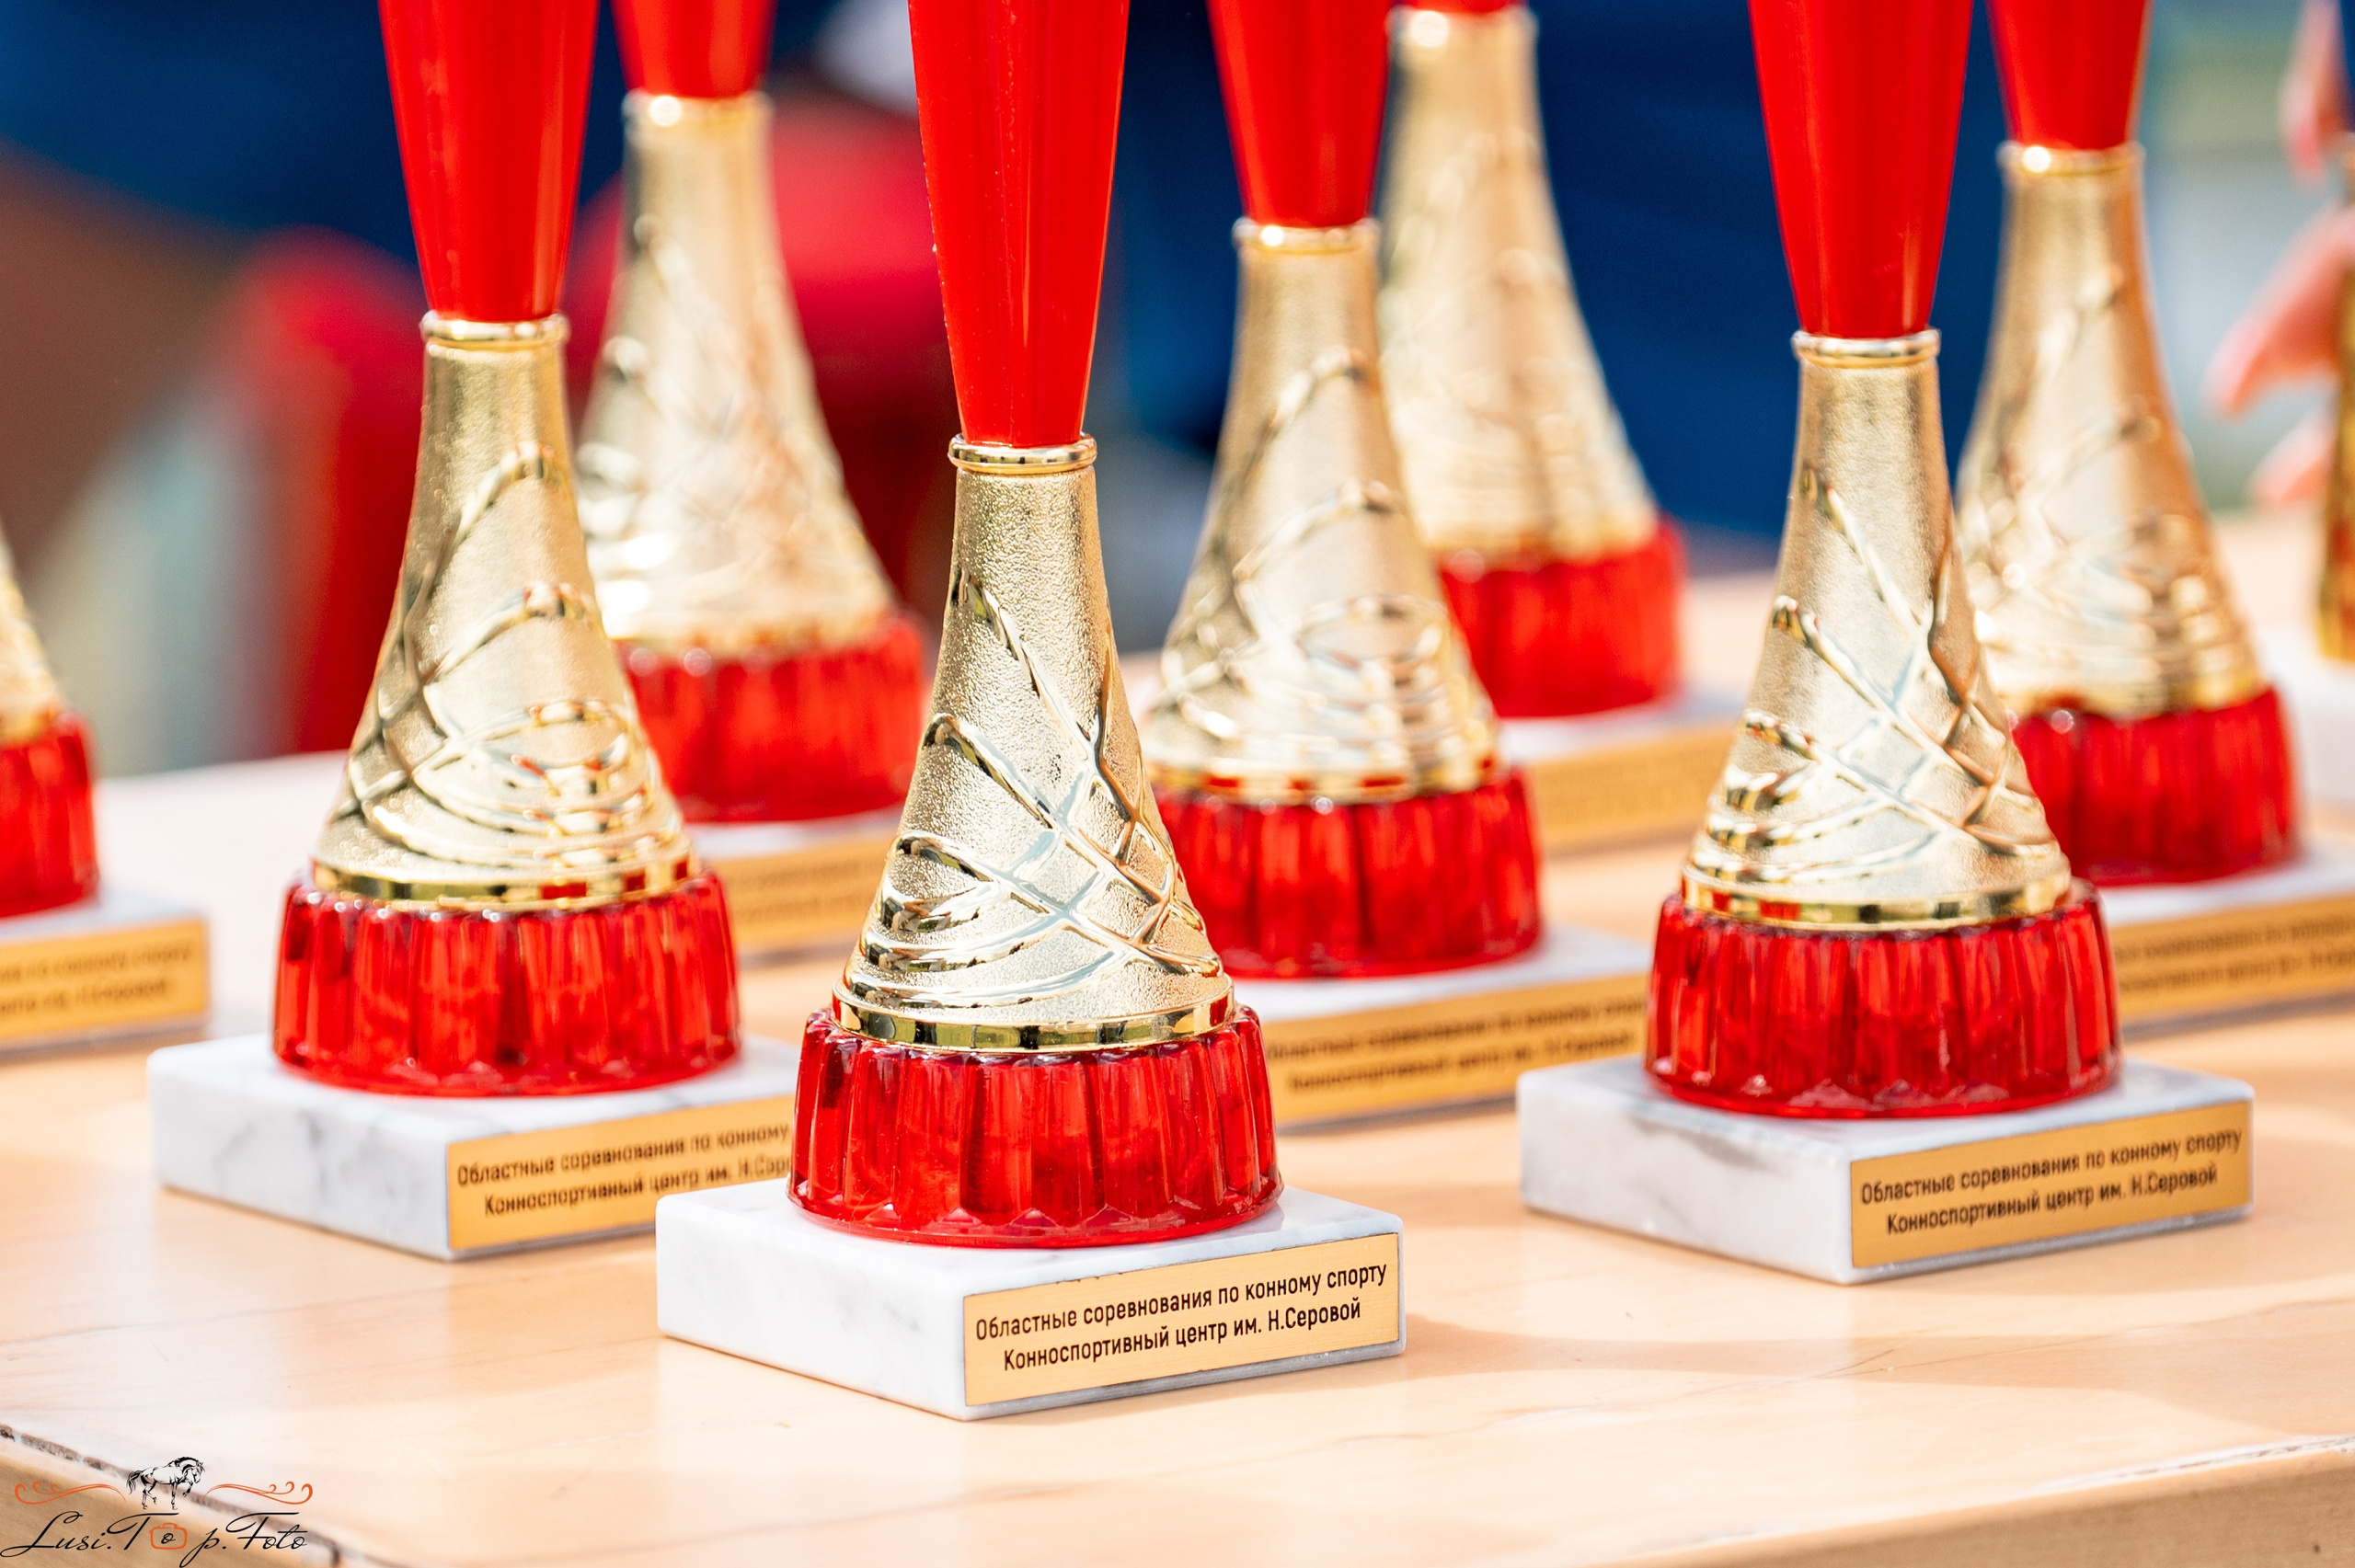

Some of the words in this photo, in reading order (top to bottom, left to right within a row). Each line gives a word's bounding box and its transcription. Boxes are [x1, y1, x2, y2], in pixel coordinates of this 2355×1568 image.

[1861, 1174, 1955, 1205] Областные
[1960, 1155, 2079, 1190] соревнования
[2085, 1150, 2105, 1169] по
[2109, 1140, 2181, 1165] конному
[2186, 1128, 2242, 1155] спорту
[1888, 1190, 2040, 1234] Конноспортивный
[2045, 1186, 2094, 1211] центр
[2098, 1184, 2125, 1201] им.
[2131, 1162, 2217, 1196] Н.Серовой
[976, 1310, 1076, 1340] Областные
[1084, 1290, 1212, 1326] соревнования
[1219, 1287, 1239, 1305] по
[1246, 1274, 1321, 1300] конному
[1327, 1263, 1386, 1290] спорту
[1005, 1325, 1168, 1371] Конноспортивный
[1176, 1322, 1227, 1347] центр
[1234, 1318, 1261, 1336] им.
[1269, 1297, 1360, 1332] Н.Серовой
